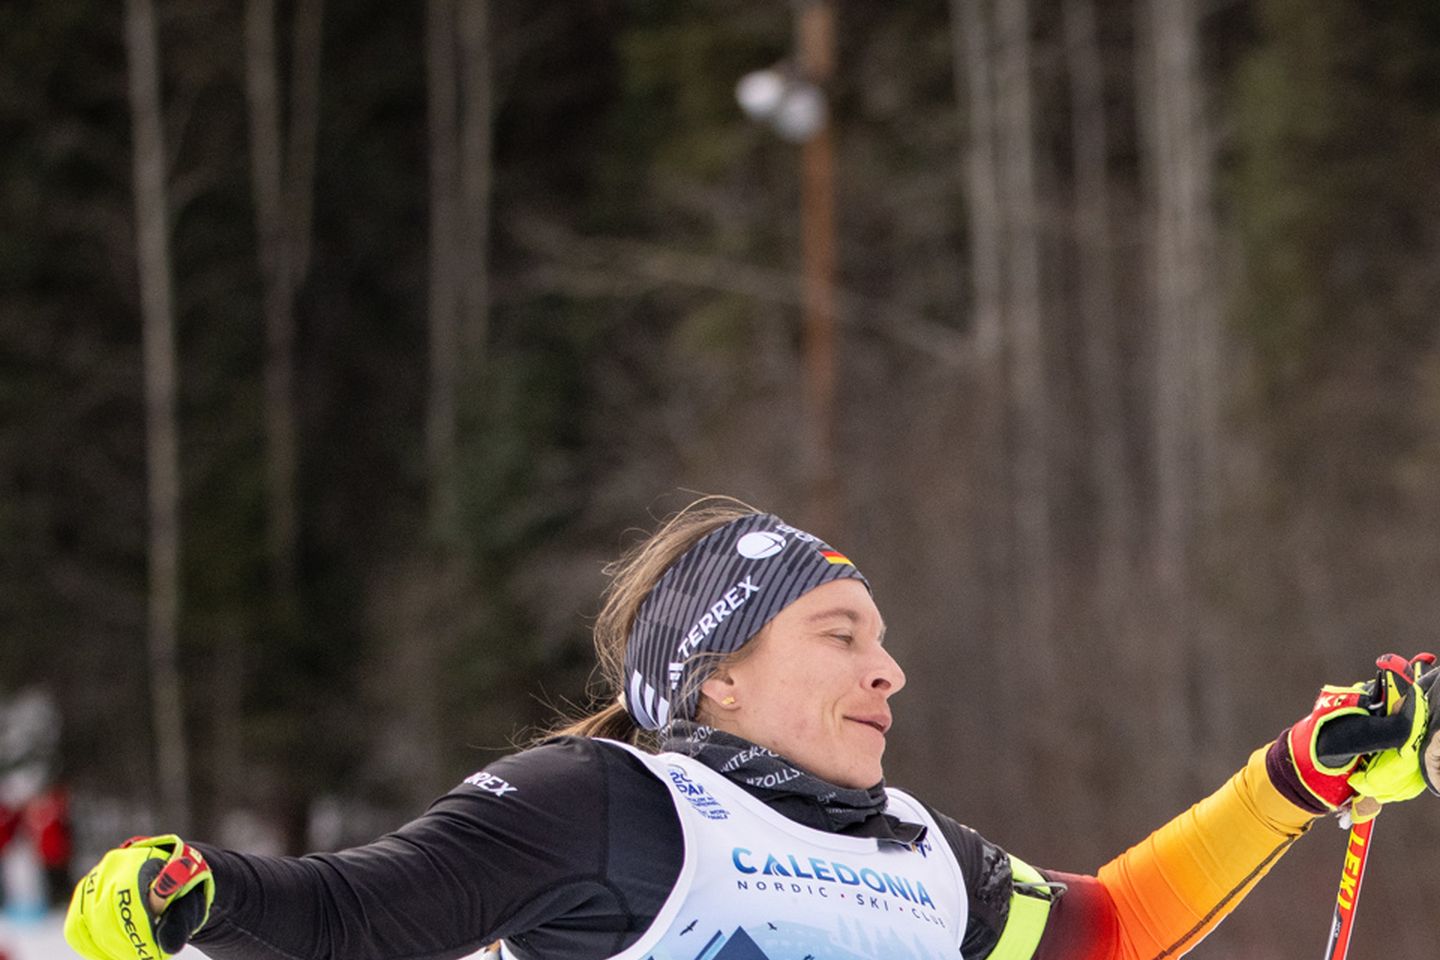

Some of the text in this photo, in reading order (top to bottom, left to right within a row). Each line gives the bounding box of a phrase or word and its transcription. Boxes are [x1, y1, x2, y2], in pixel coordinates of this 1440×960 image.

[677, 575, 760, 658] TERREX
[732, 847, 937, 911] CALEDONIA
[737, 880, 829, 898] NORDIC
[856, 893, 889, 912] SKI
[1336, 828, 1366, 911] LEKI
